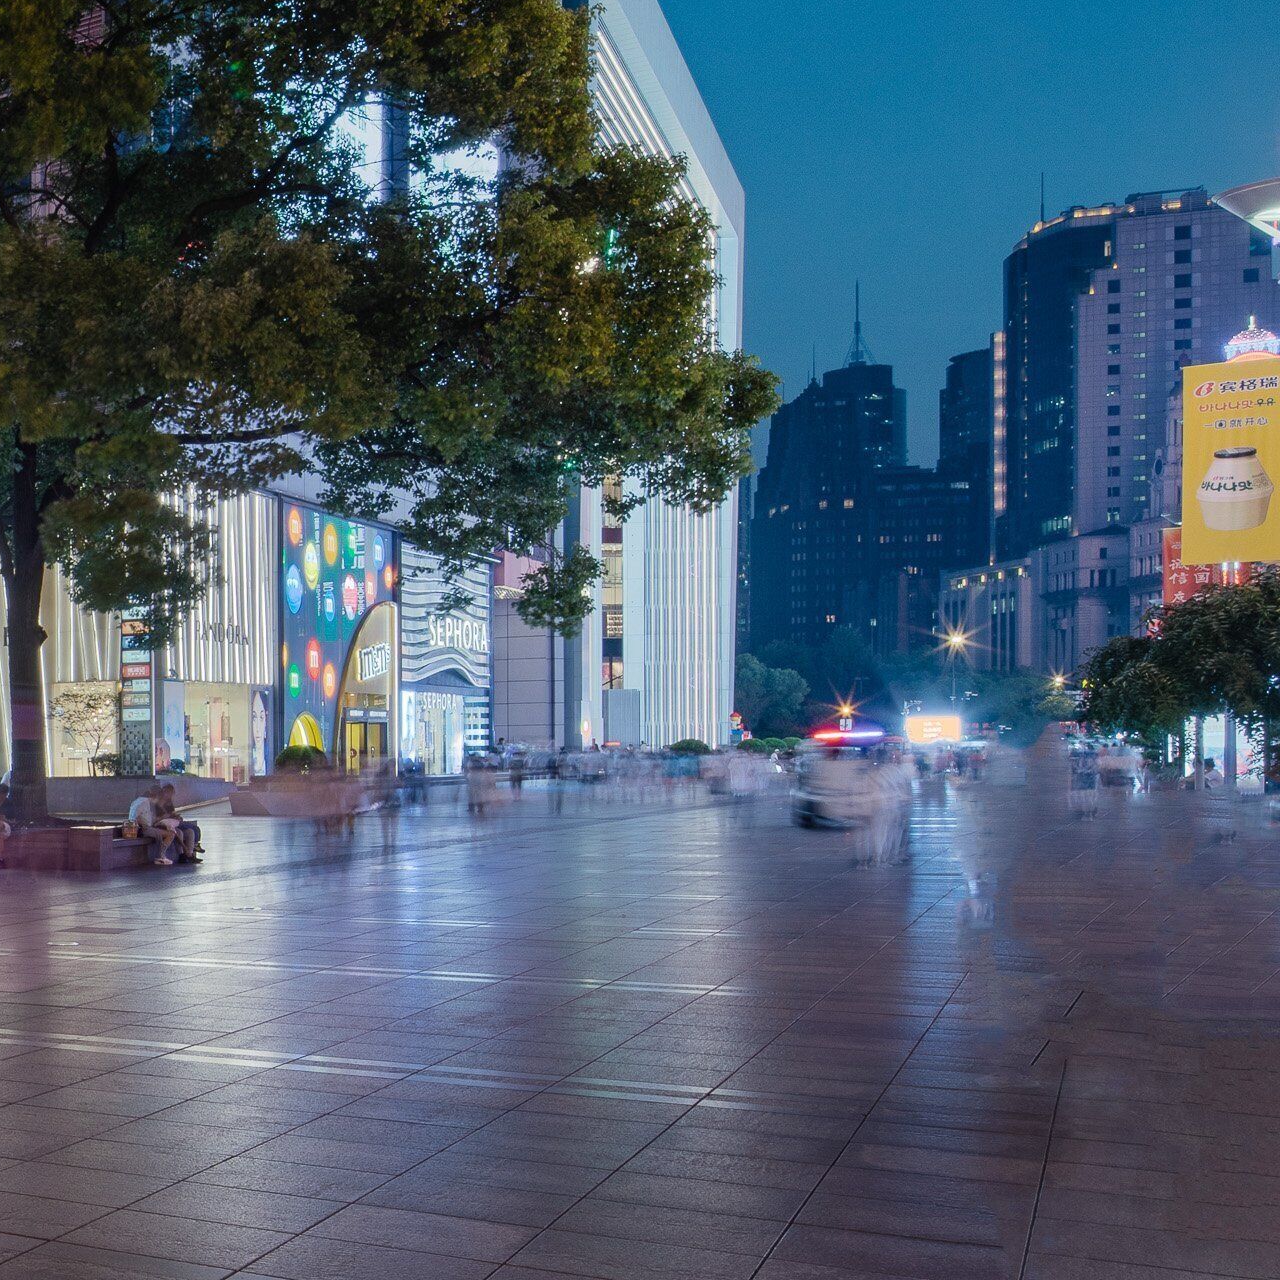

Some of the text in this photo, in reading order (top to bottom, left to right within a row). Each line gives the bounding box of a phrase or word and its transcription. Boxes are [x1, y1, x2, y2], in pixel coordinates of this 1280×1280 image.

[1219, 376, 1278, 394] 宾格瑞
[196, 620, 249, 646] PANDORA
[427, 614, 489, 653] SEPHORA
[421, 693, 459, 711] SEPHORA
